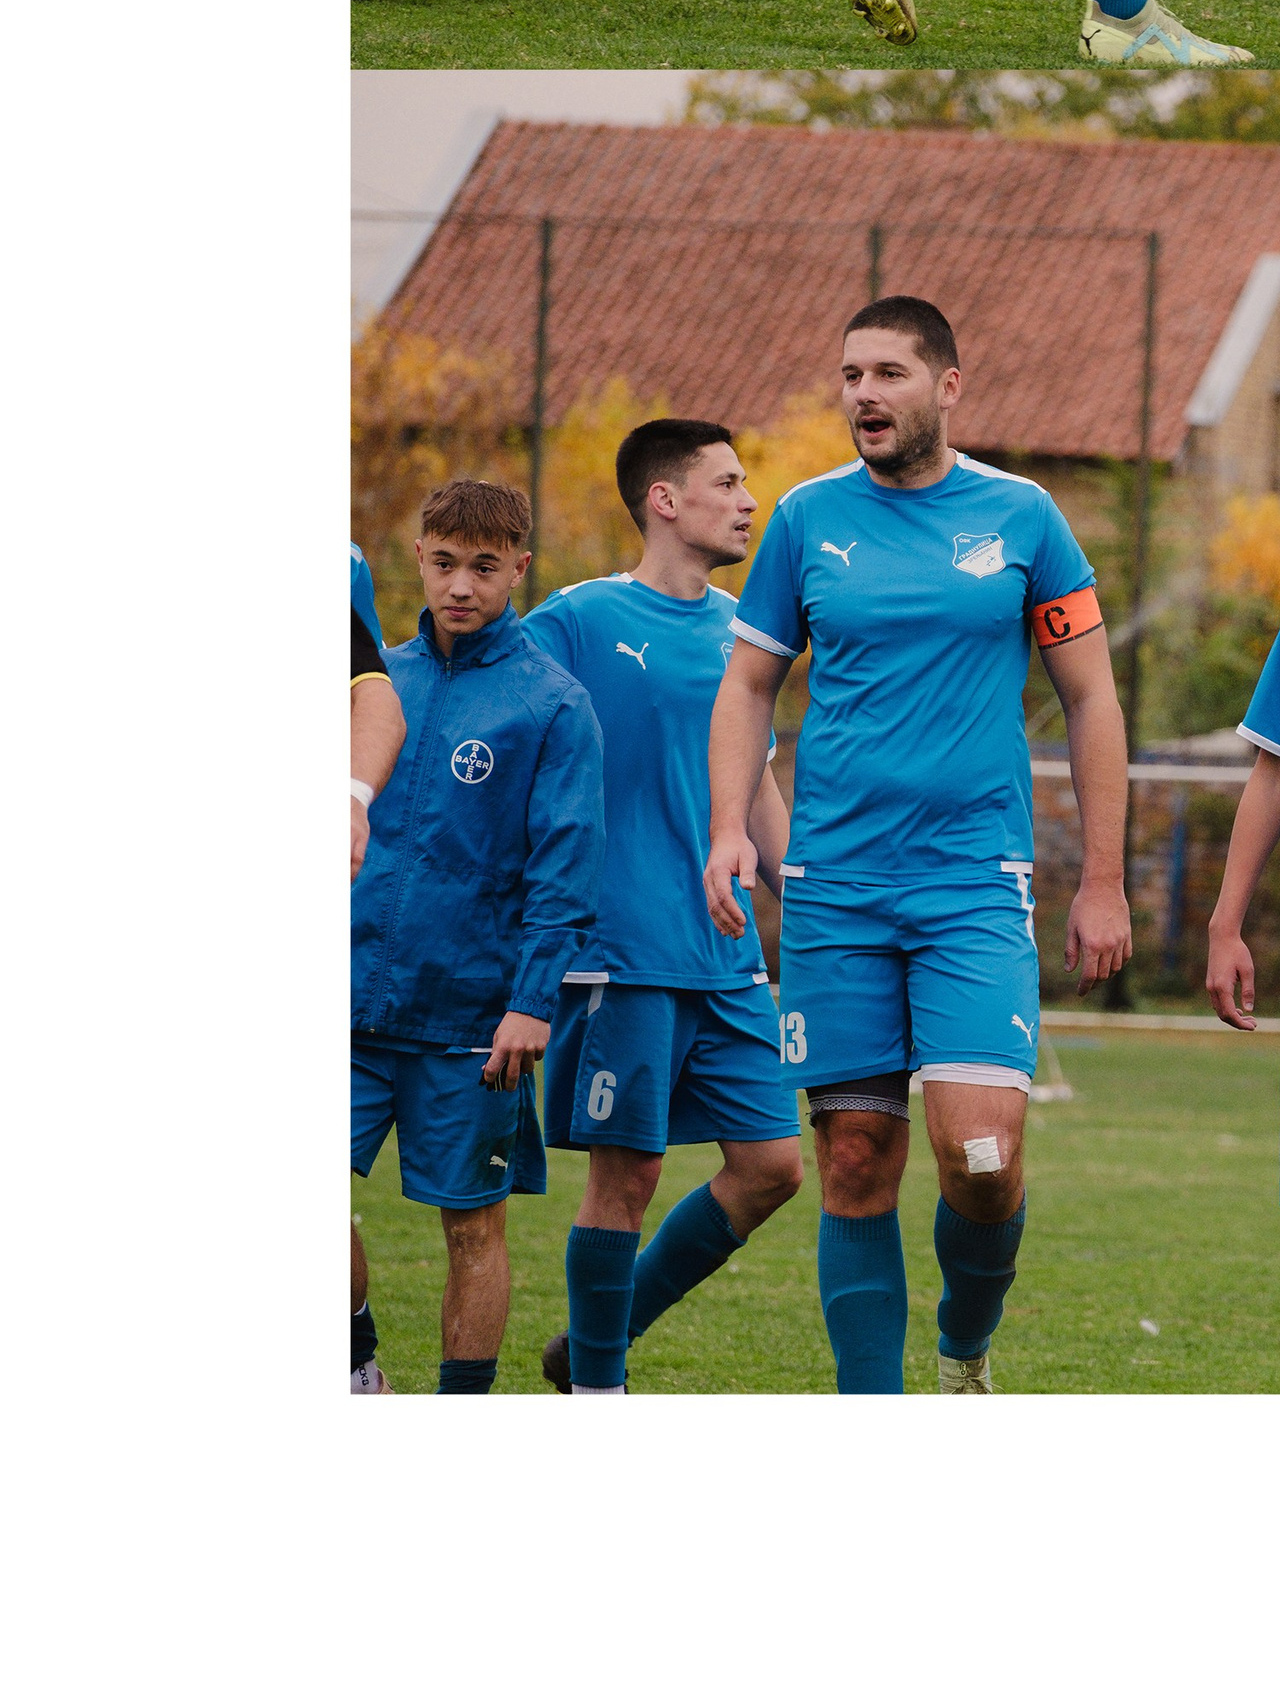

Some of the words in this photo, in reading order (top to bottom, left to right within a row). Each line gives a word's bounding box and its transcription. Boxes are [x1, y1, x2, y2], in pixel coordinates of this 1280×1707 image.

[1044, 606, 1071, 639] C
[454, 754, 490, 770] BAYER
[465, 743, 480, 781] BAYER
[778, 1011, 808, 1064] 13
[587, 1070, 617, 1121] 6
